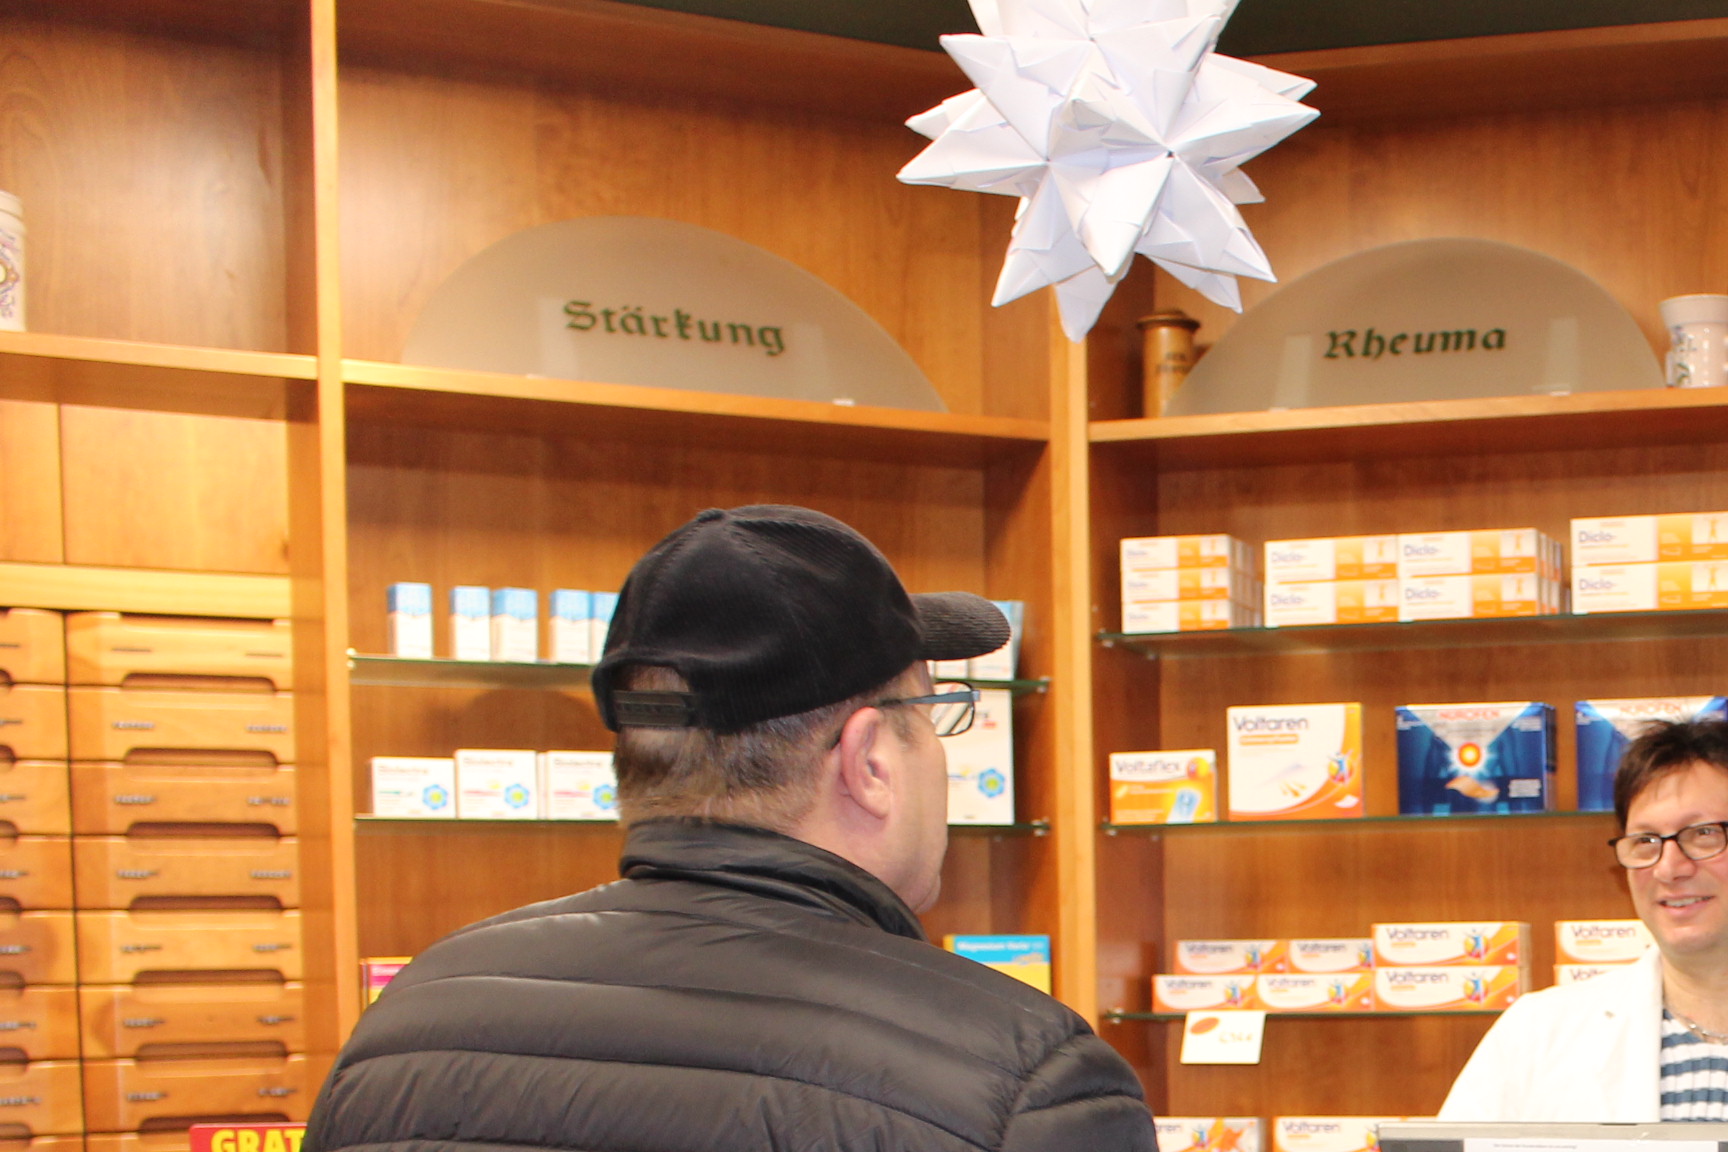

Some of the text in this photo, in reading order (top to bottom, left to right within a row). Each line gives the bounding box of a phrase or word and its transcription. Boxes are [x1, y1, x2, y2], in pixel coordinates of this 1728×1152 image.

[563, 300, 785, 356] Stärkung
[1323, 326, 1507, 359] Rheuma
[1233, 716, 1310, 732] Voltaren
[1385, 927, 1450, 940] Voltaren
[1571, 925, 1636, 939] Voltaren
[1385, 970, 1449, 983] Voltaren
[1282, 1121, 1340, 1134] Voltaren
